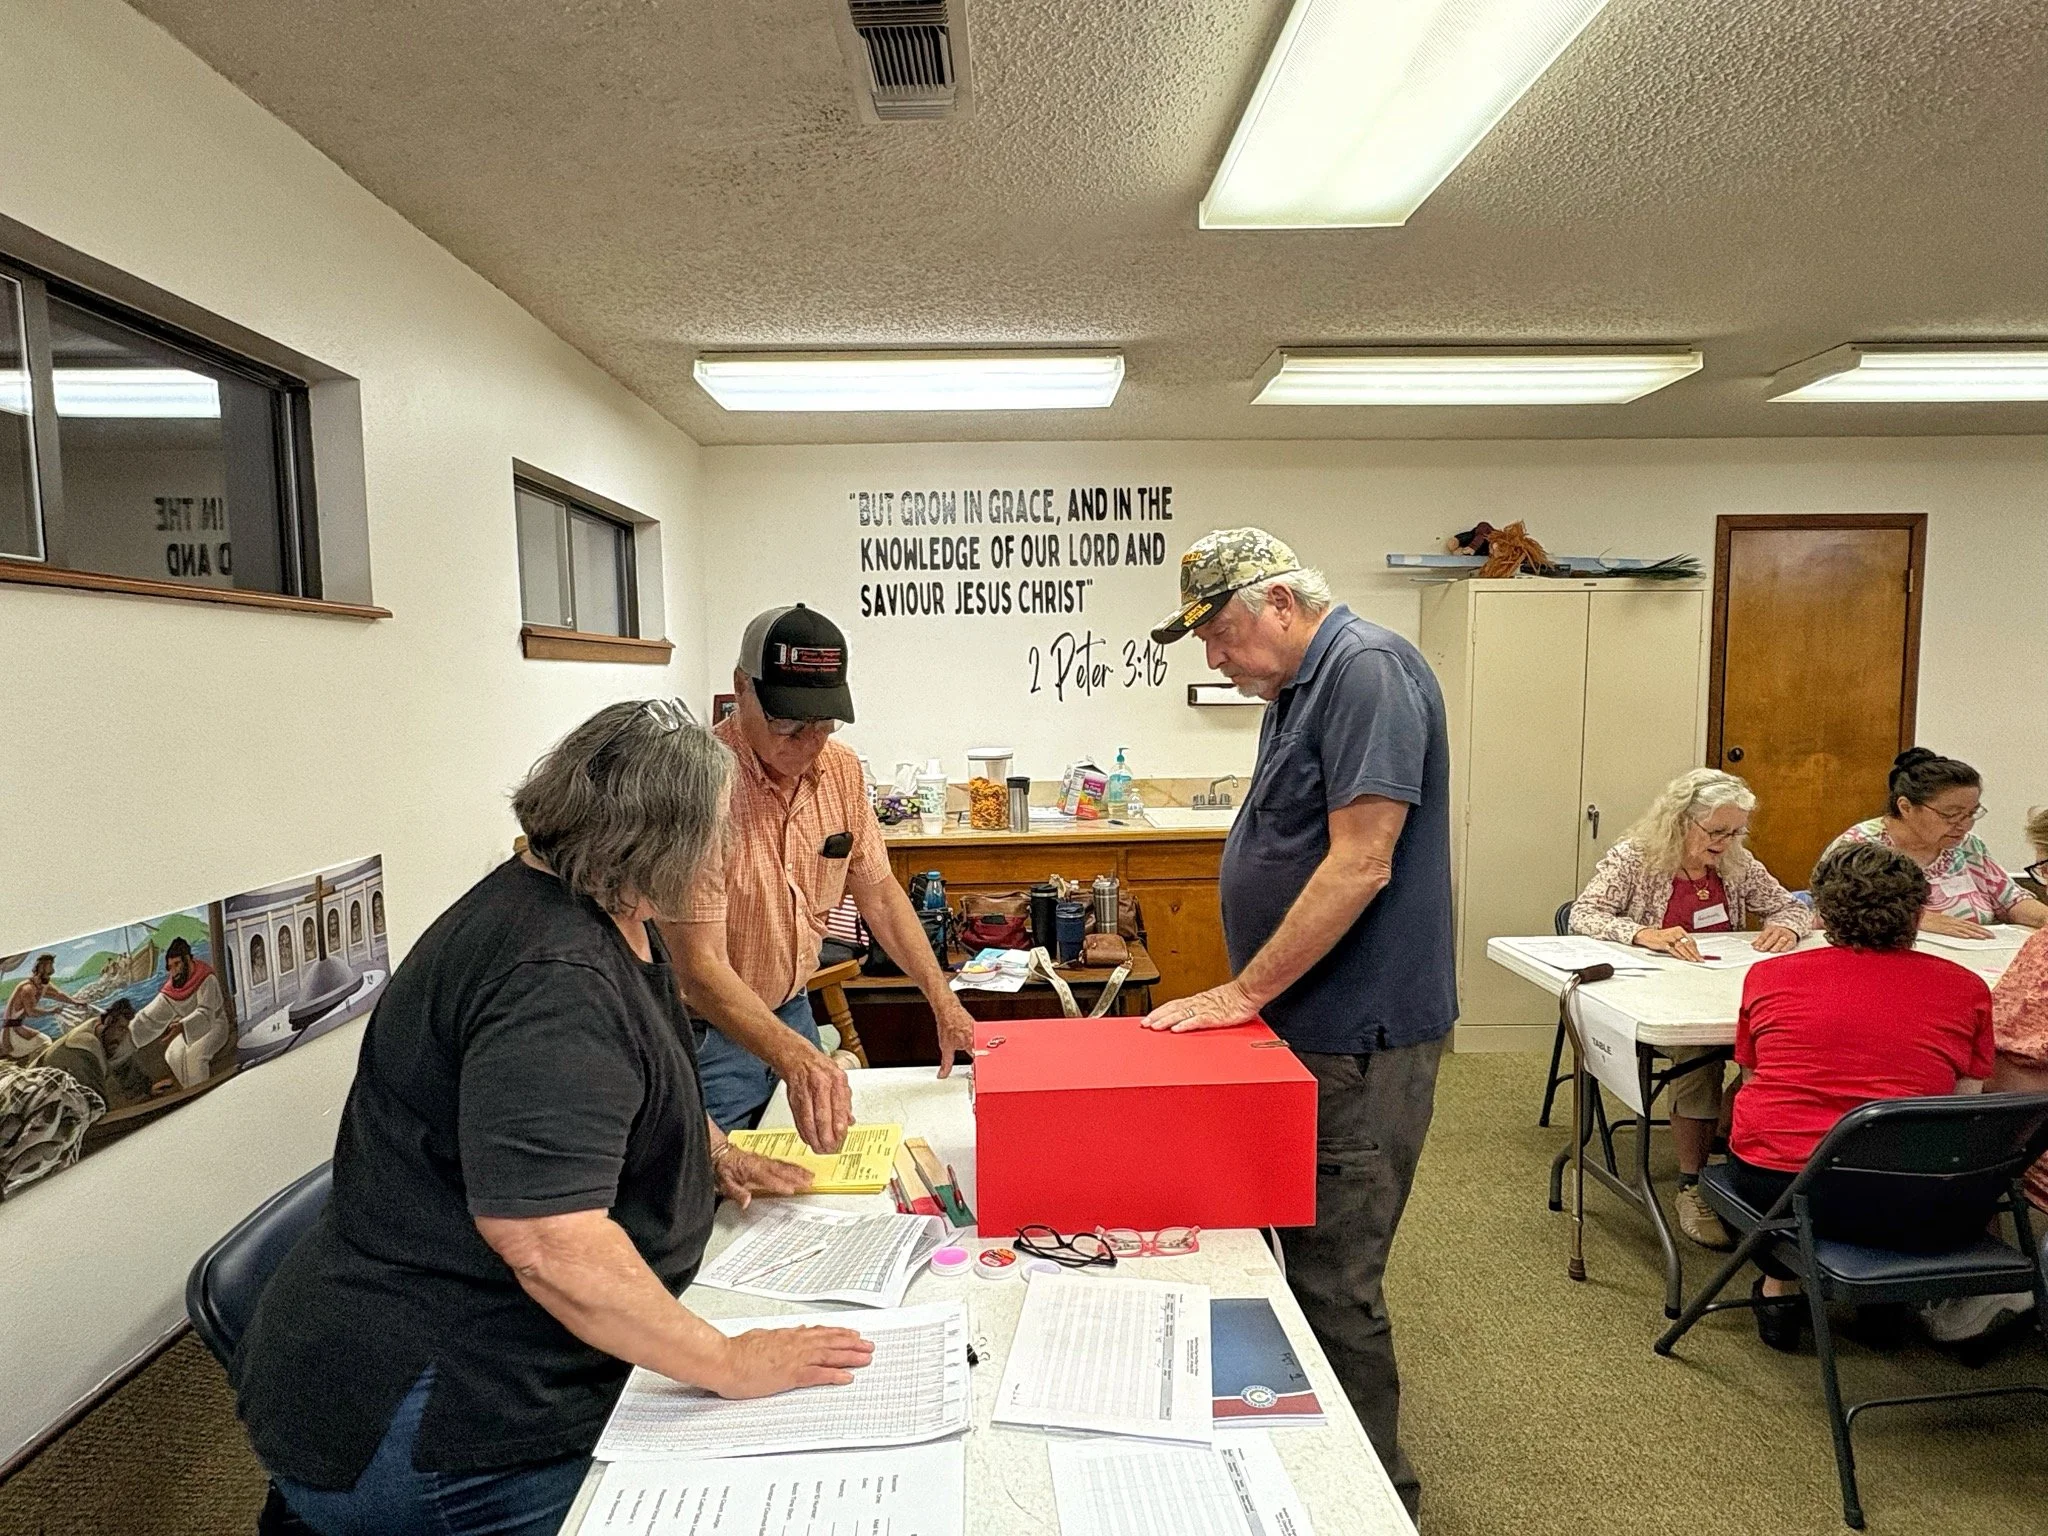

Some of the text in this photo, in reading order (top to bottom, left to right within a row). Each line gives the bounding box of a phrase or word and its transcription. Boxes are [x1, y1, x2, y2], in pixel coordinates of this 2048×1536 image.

[901, 490, 957, 526] GROW
[964, 490, 982, 524] IN
[989, 489, 1061, 526] GRACE,
[1068, 488, 1107, 522] AND
[1114, 487, 1132, 521] IN
[1138, 486, 1173, 521] THE
[861, 536, 981, 572] KNOWLEDGE
[991, 535, 1014, 569] OF
[1021, 534, 1060, 567] OUR
[1069, 533, 1120, 567] LORD
[1125, 532, 1165, 566] AND
[861, 579, 1093, 617] SAVIOUR JESUS CHRIST"
[1029, 630, 1168, 702] 2 Peter 3:18
[1592, 1037, 1613, 1056] TABLE
